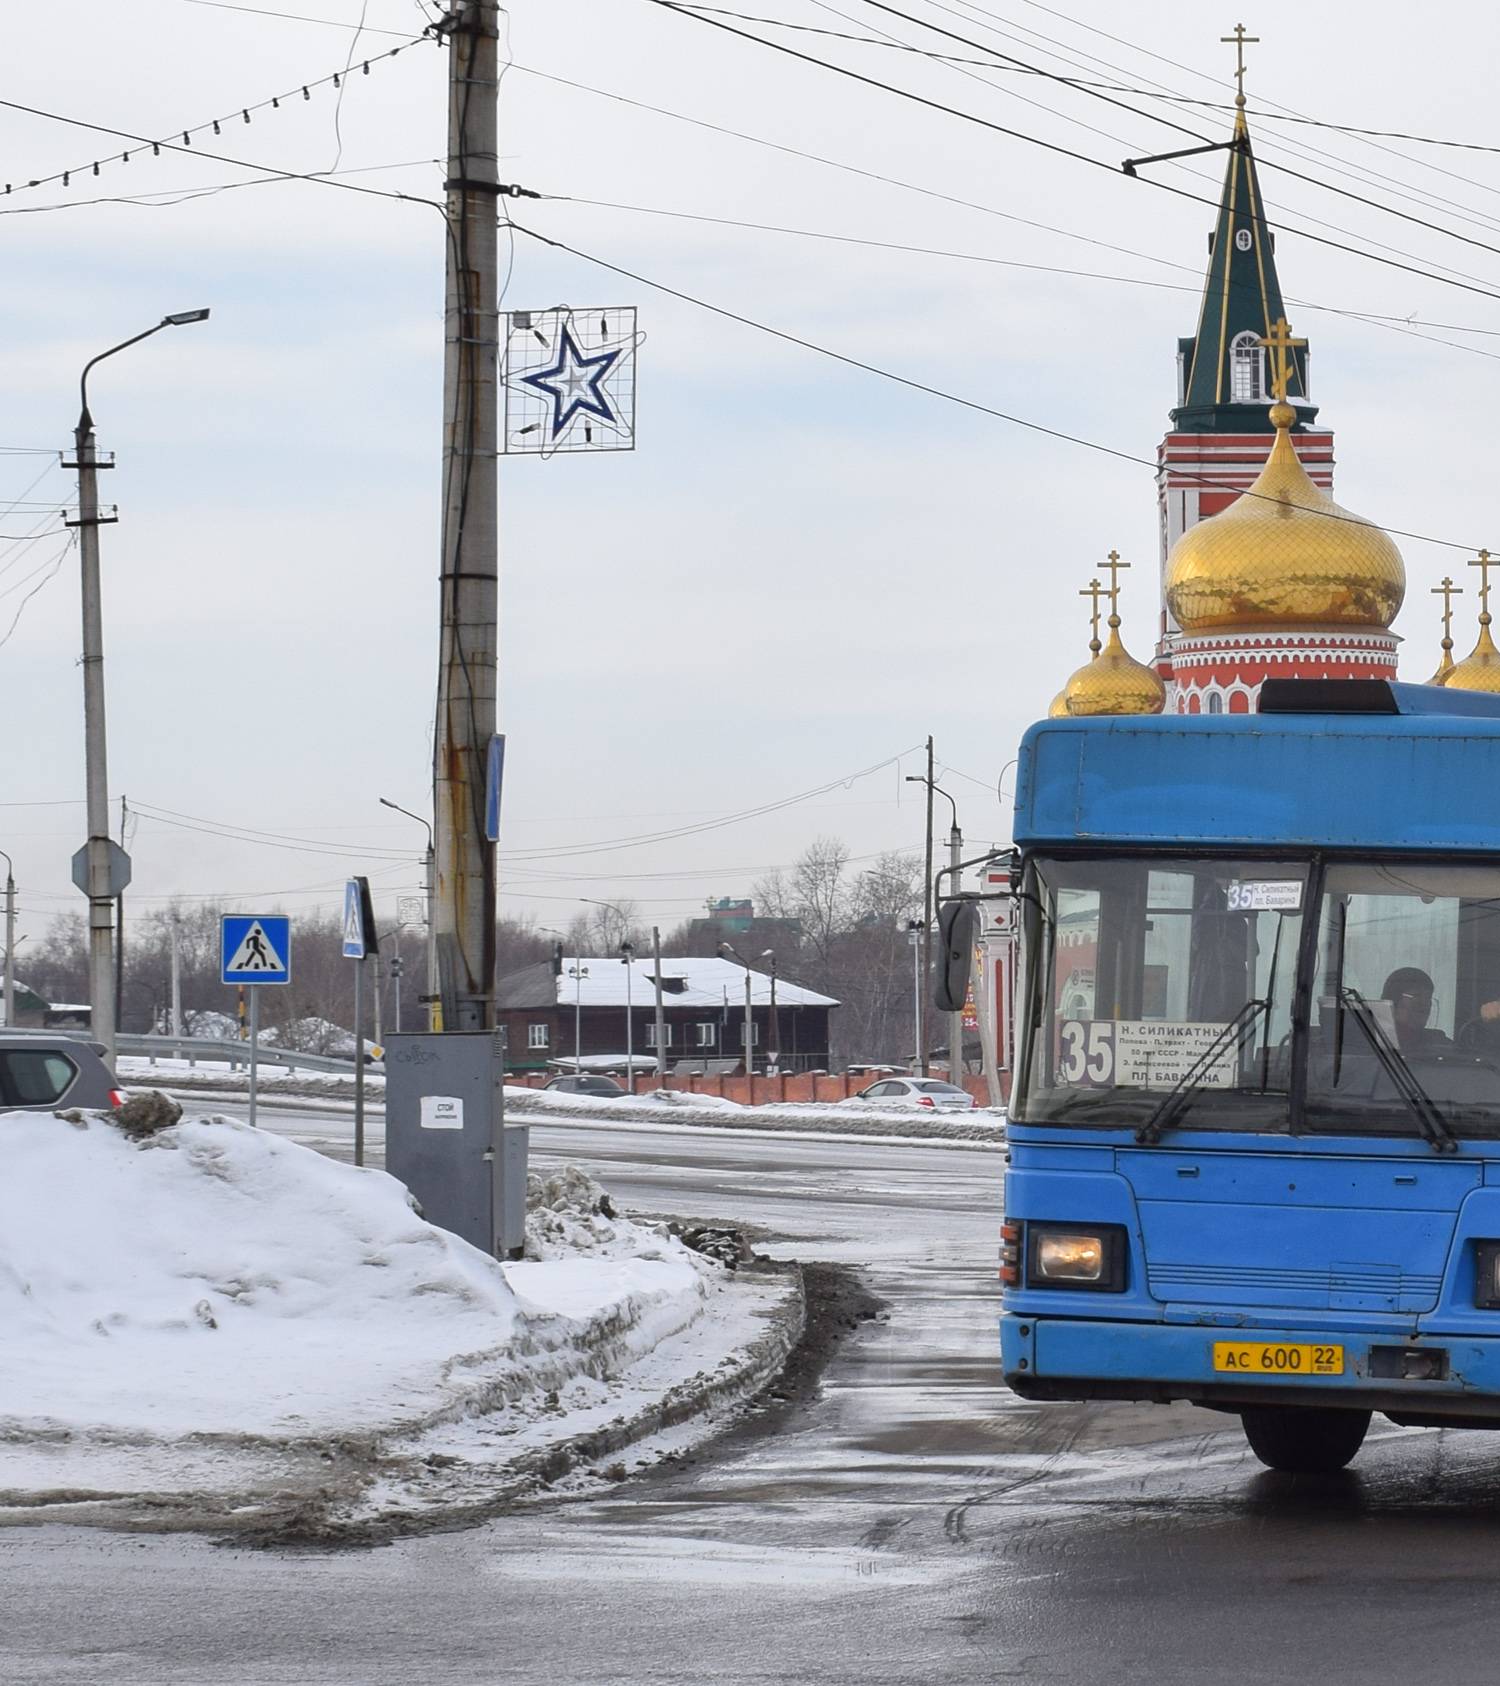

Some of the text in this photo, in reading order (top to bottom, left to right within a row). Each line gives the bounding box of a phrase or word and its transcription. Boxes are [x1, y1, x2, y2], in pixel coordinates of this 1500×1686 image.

[1228, 885, 1253, 908] 35
[1121, 1026, 1134, 1035] Н.
[1062, 1021, 1113, 1082] 35
[1131, 1071, 1151, 1081] ПЛ.
[1261, 1347, 1302, 1369] 600
[1314, 1347, 1335, 1364] 22
